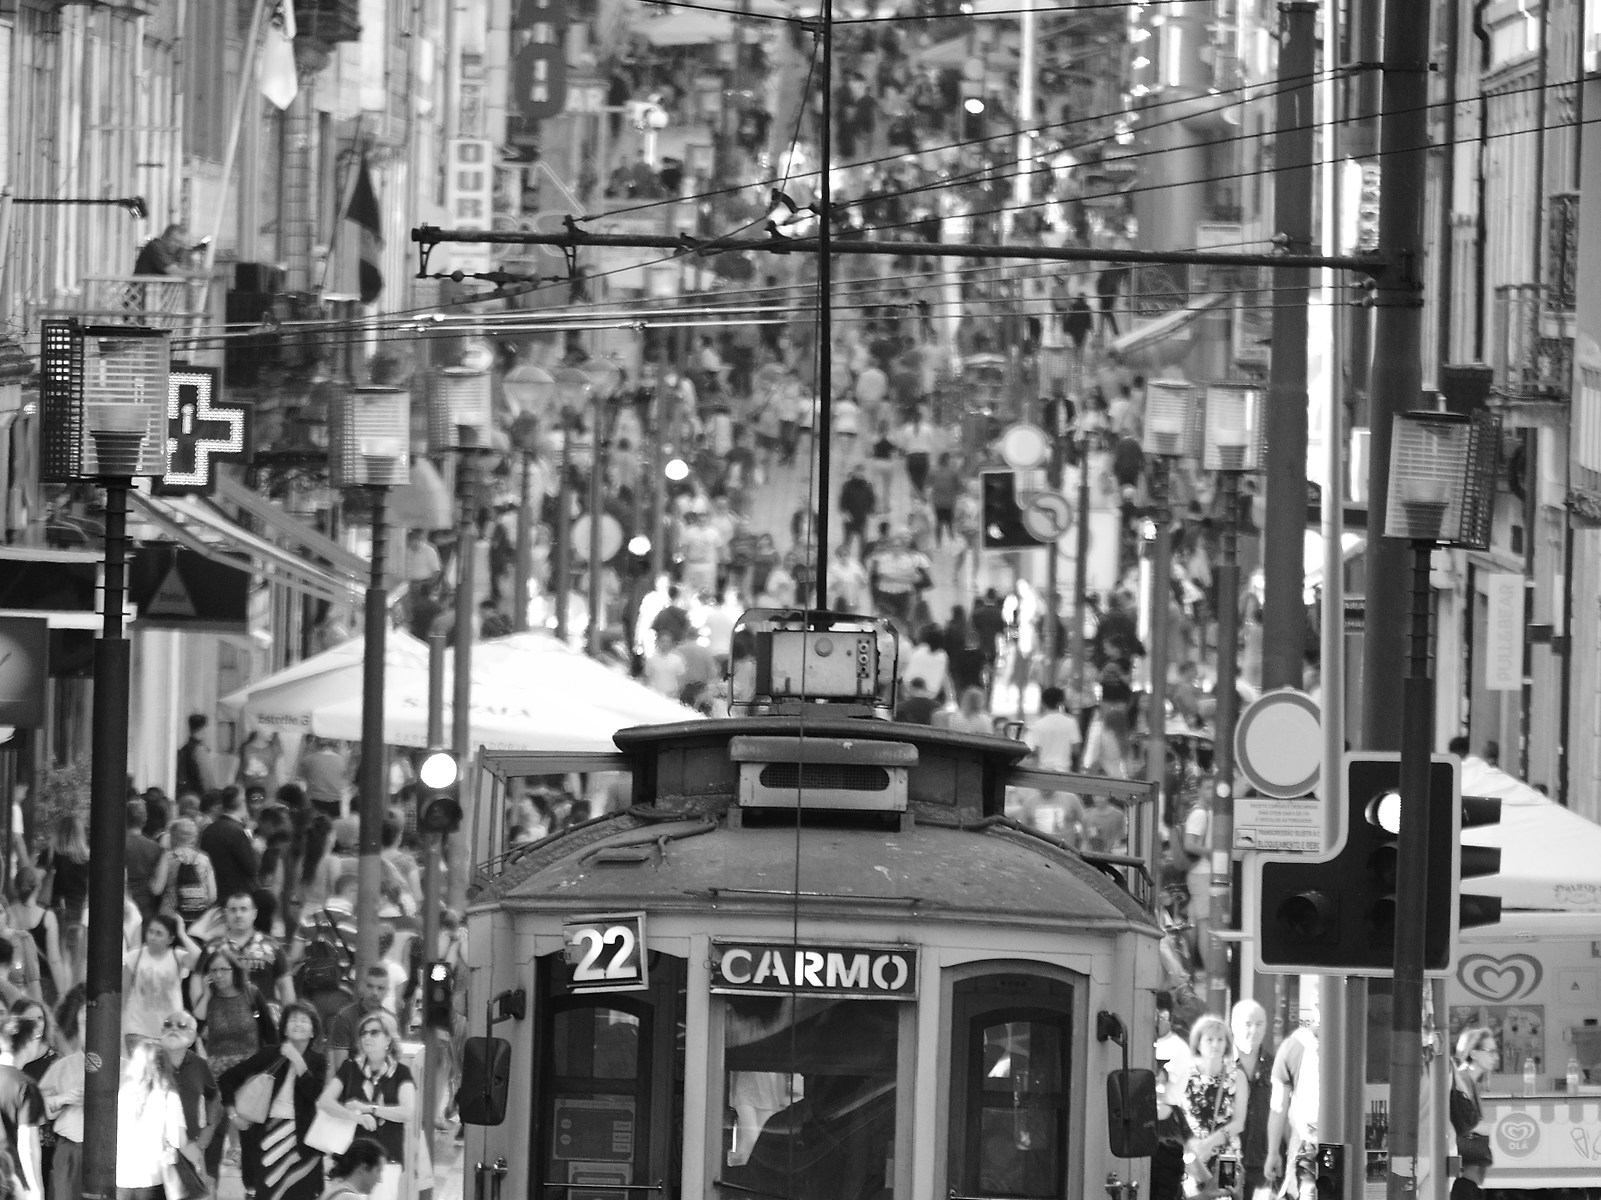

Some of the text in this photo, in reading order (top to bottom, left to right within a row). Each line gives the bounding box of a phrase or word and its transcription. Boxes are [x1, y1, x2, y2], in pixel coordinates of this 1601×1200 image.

[1496, 584, 1515, 681] PULL&BEAR
[573, 925, 638, 982] 22
[720, 948, 908, 991] CARMO
